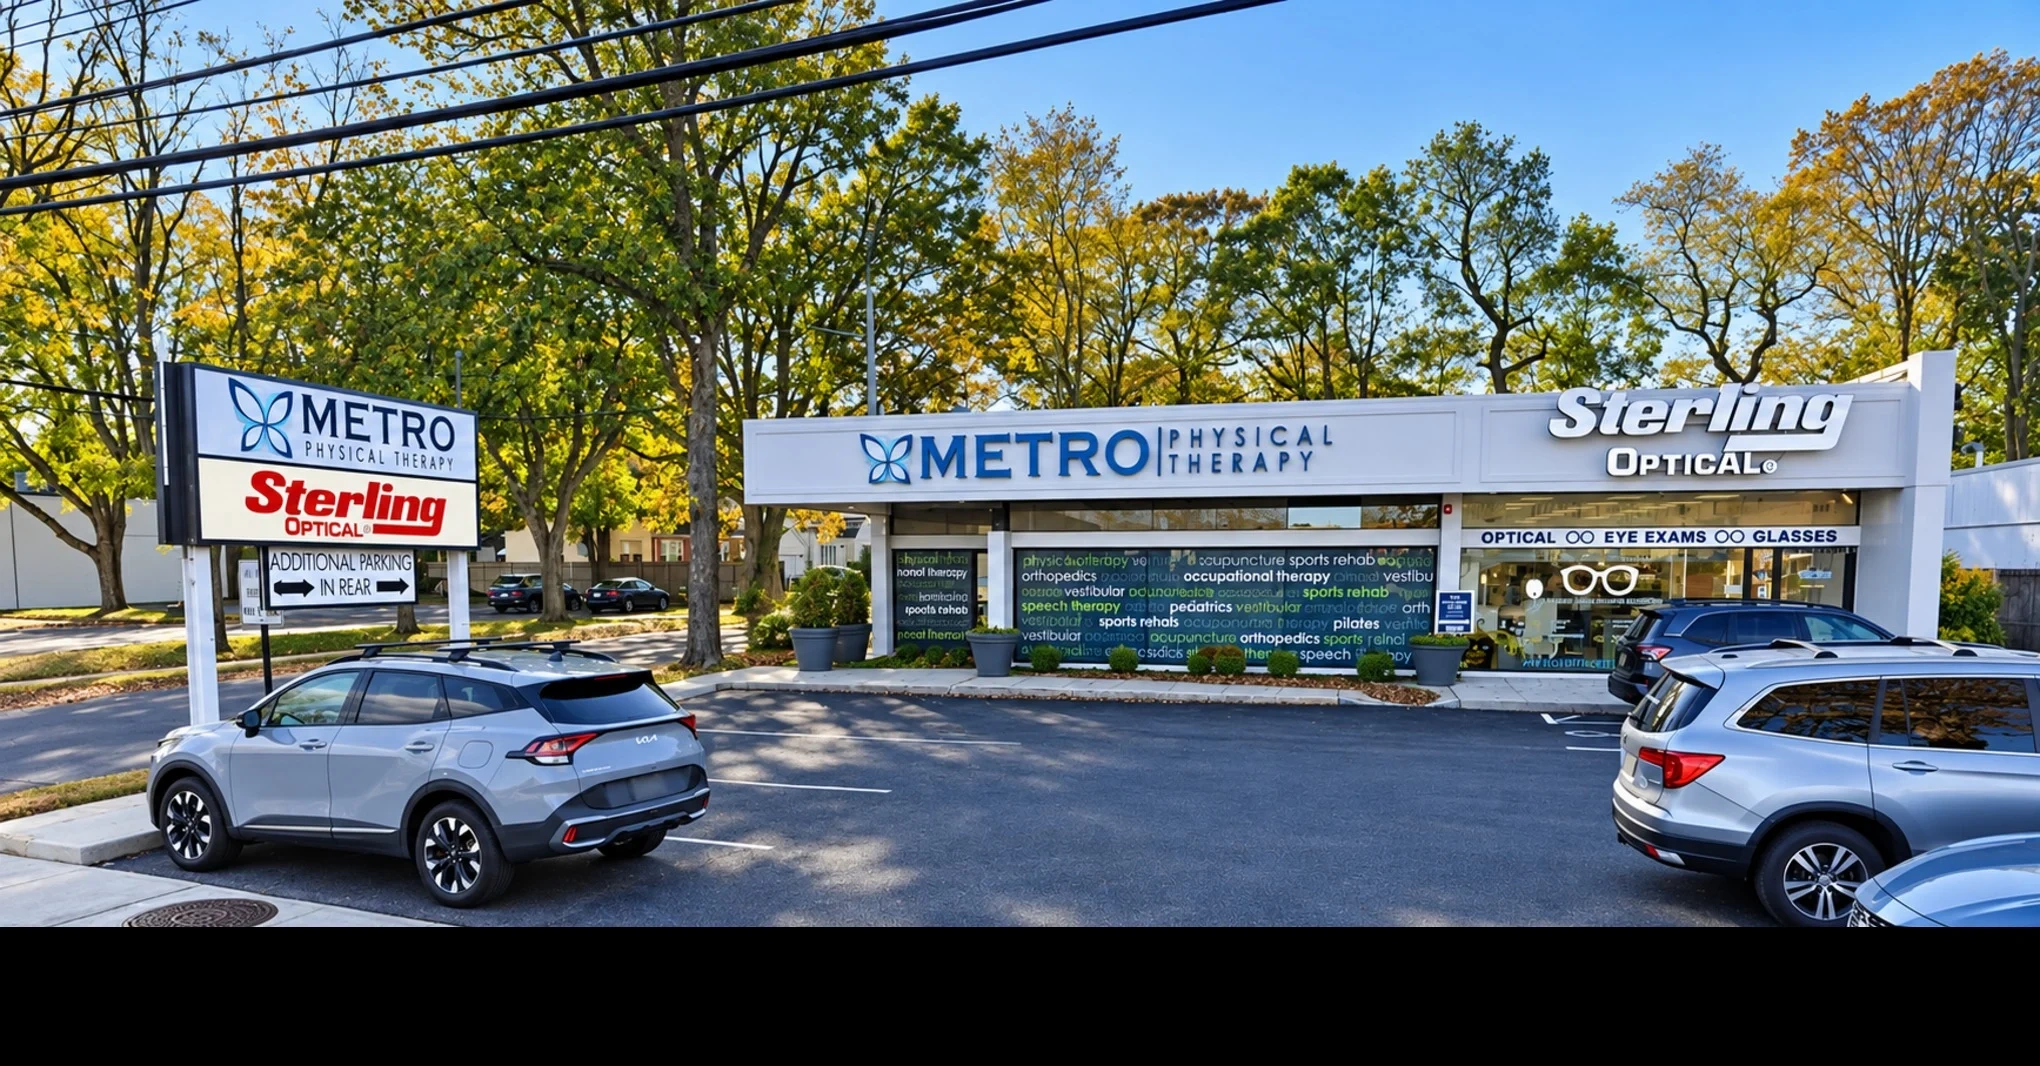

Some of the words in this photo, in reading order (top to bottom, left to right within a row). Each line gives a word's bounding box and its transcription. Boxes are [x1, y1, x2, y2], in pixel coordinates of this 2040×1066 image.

[302, 394, 455, 452] METRO
[1548, 383, 1854, 453] Sterling
[1169, 424, 1334, 448] PHYSICAL
[305, 441, 385, 465] PHYSICAL
[395, 451, 454, 472] THERAPY
[920, 429, 1150, 479] METRO
[1169, 451, 1315, 475] THERAPY
[245, 471, 446, 536] Sterling
[1481, 530, 1556, 545] OPTICAL
[1604, 530, 1638, 544] EYE
[1645, 530, 1707, 544] EXAMS
[1753, 530, 1838, 543] GLASSES
[270, 552, 357, 572] ADDITIONAL
[360, 554, 412, 572] PARKING
[1289, 554, 1329, 569] sports
[1333, 553, 1376, 567] rehab
[1022, 570, 1098, 584] orthopedics
[1184, 570, 1274, 585] occupational
[1276, 570, 1331, 584] therapy
[320, 579, 334, 597] IN
[339, 578, 371, 596] REAR
[1064, 585, 1126, 597] vestibular
[1303, 586, 1343, 600] sports
[1347, 586, 1389, 598] rehab
[1022, 600, 1068, 614] speech
[1071, 600, 1122, 614] therapy
[1170, 600, 1233, 615] pediatrics
[1402, 602, 1431, 614] orth
[1099, 616, 1137, 629] sports
[1333, 617, 1380, 632] pilates
[1150, 631, 1237, 645] acupuncture
[1240, 631, 1320, 646] orthopedics
[1323, 633, 1364, 646] sports
[1300, 648, 1351, 663] speech
